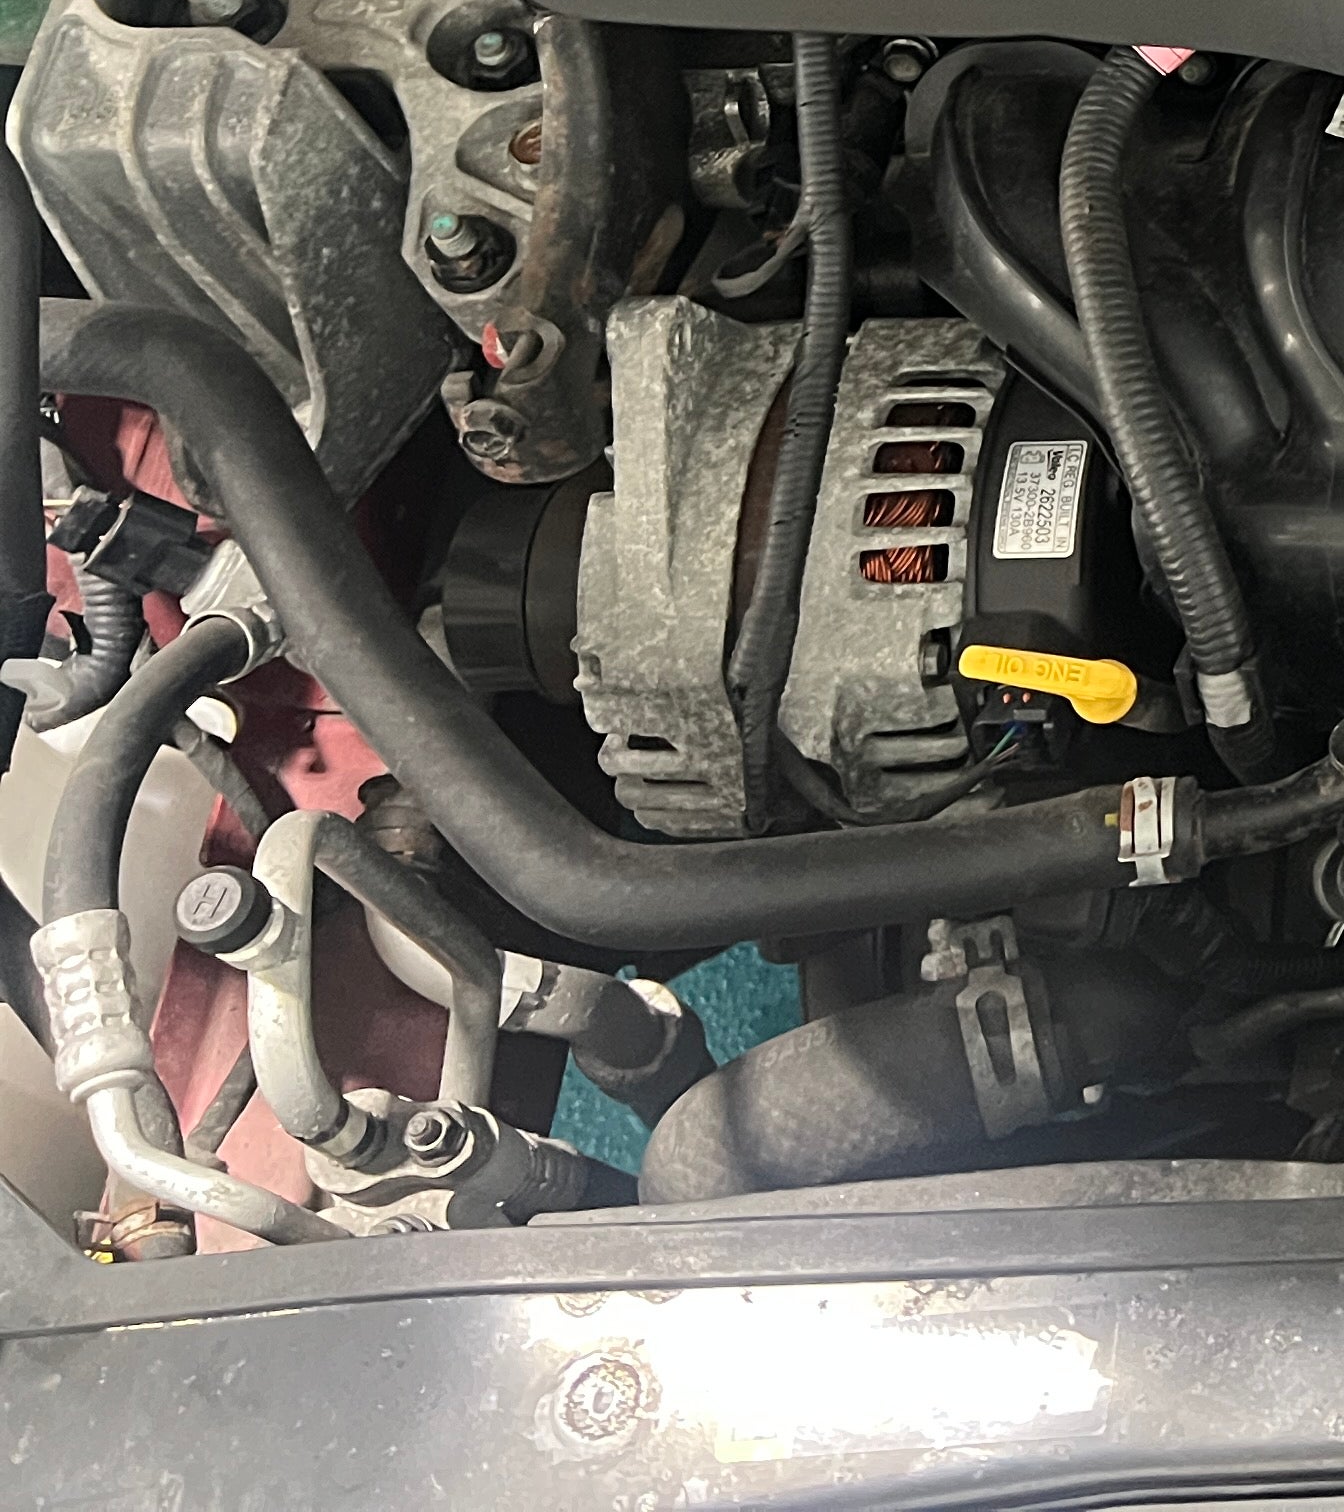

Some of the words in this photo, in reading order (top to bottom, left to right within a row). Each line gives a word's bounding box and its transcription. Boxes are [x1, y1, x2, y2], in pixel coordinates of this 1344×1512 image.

[1009, 508, 1022, 537] 130A
[1034, 488, 1056, 544] 2622503
[1059, 495, 1072, 527] BUILT
[1056, 536, 1067, 548] IN
[987, 653, 1024, 675] OIL
[1035, 660, 1086, 683] ENG
[192, 883, 228, 919] H
